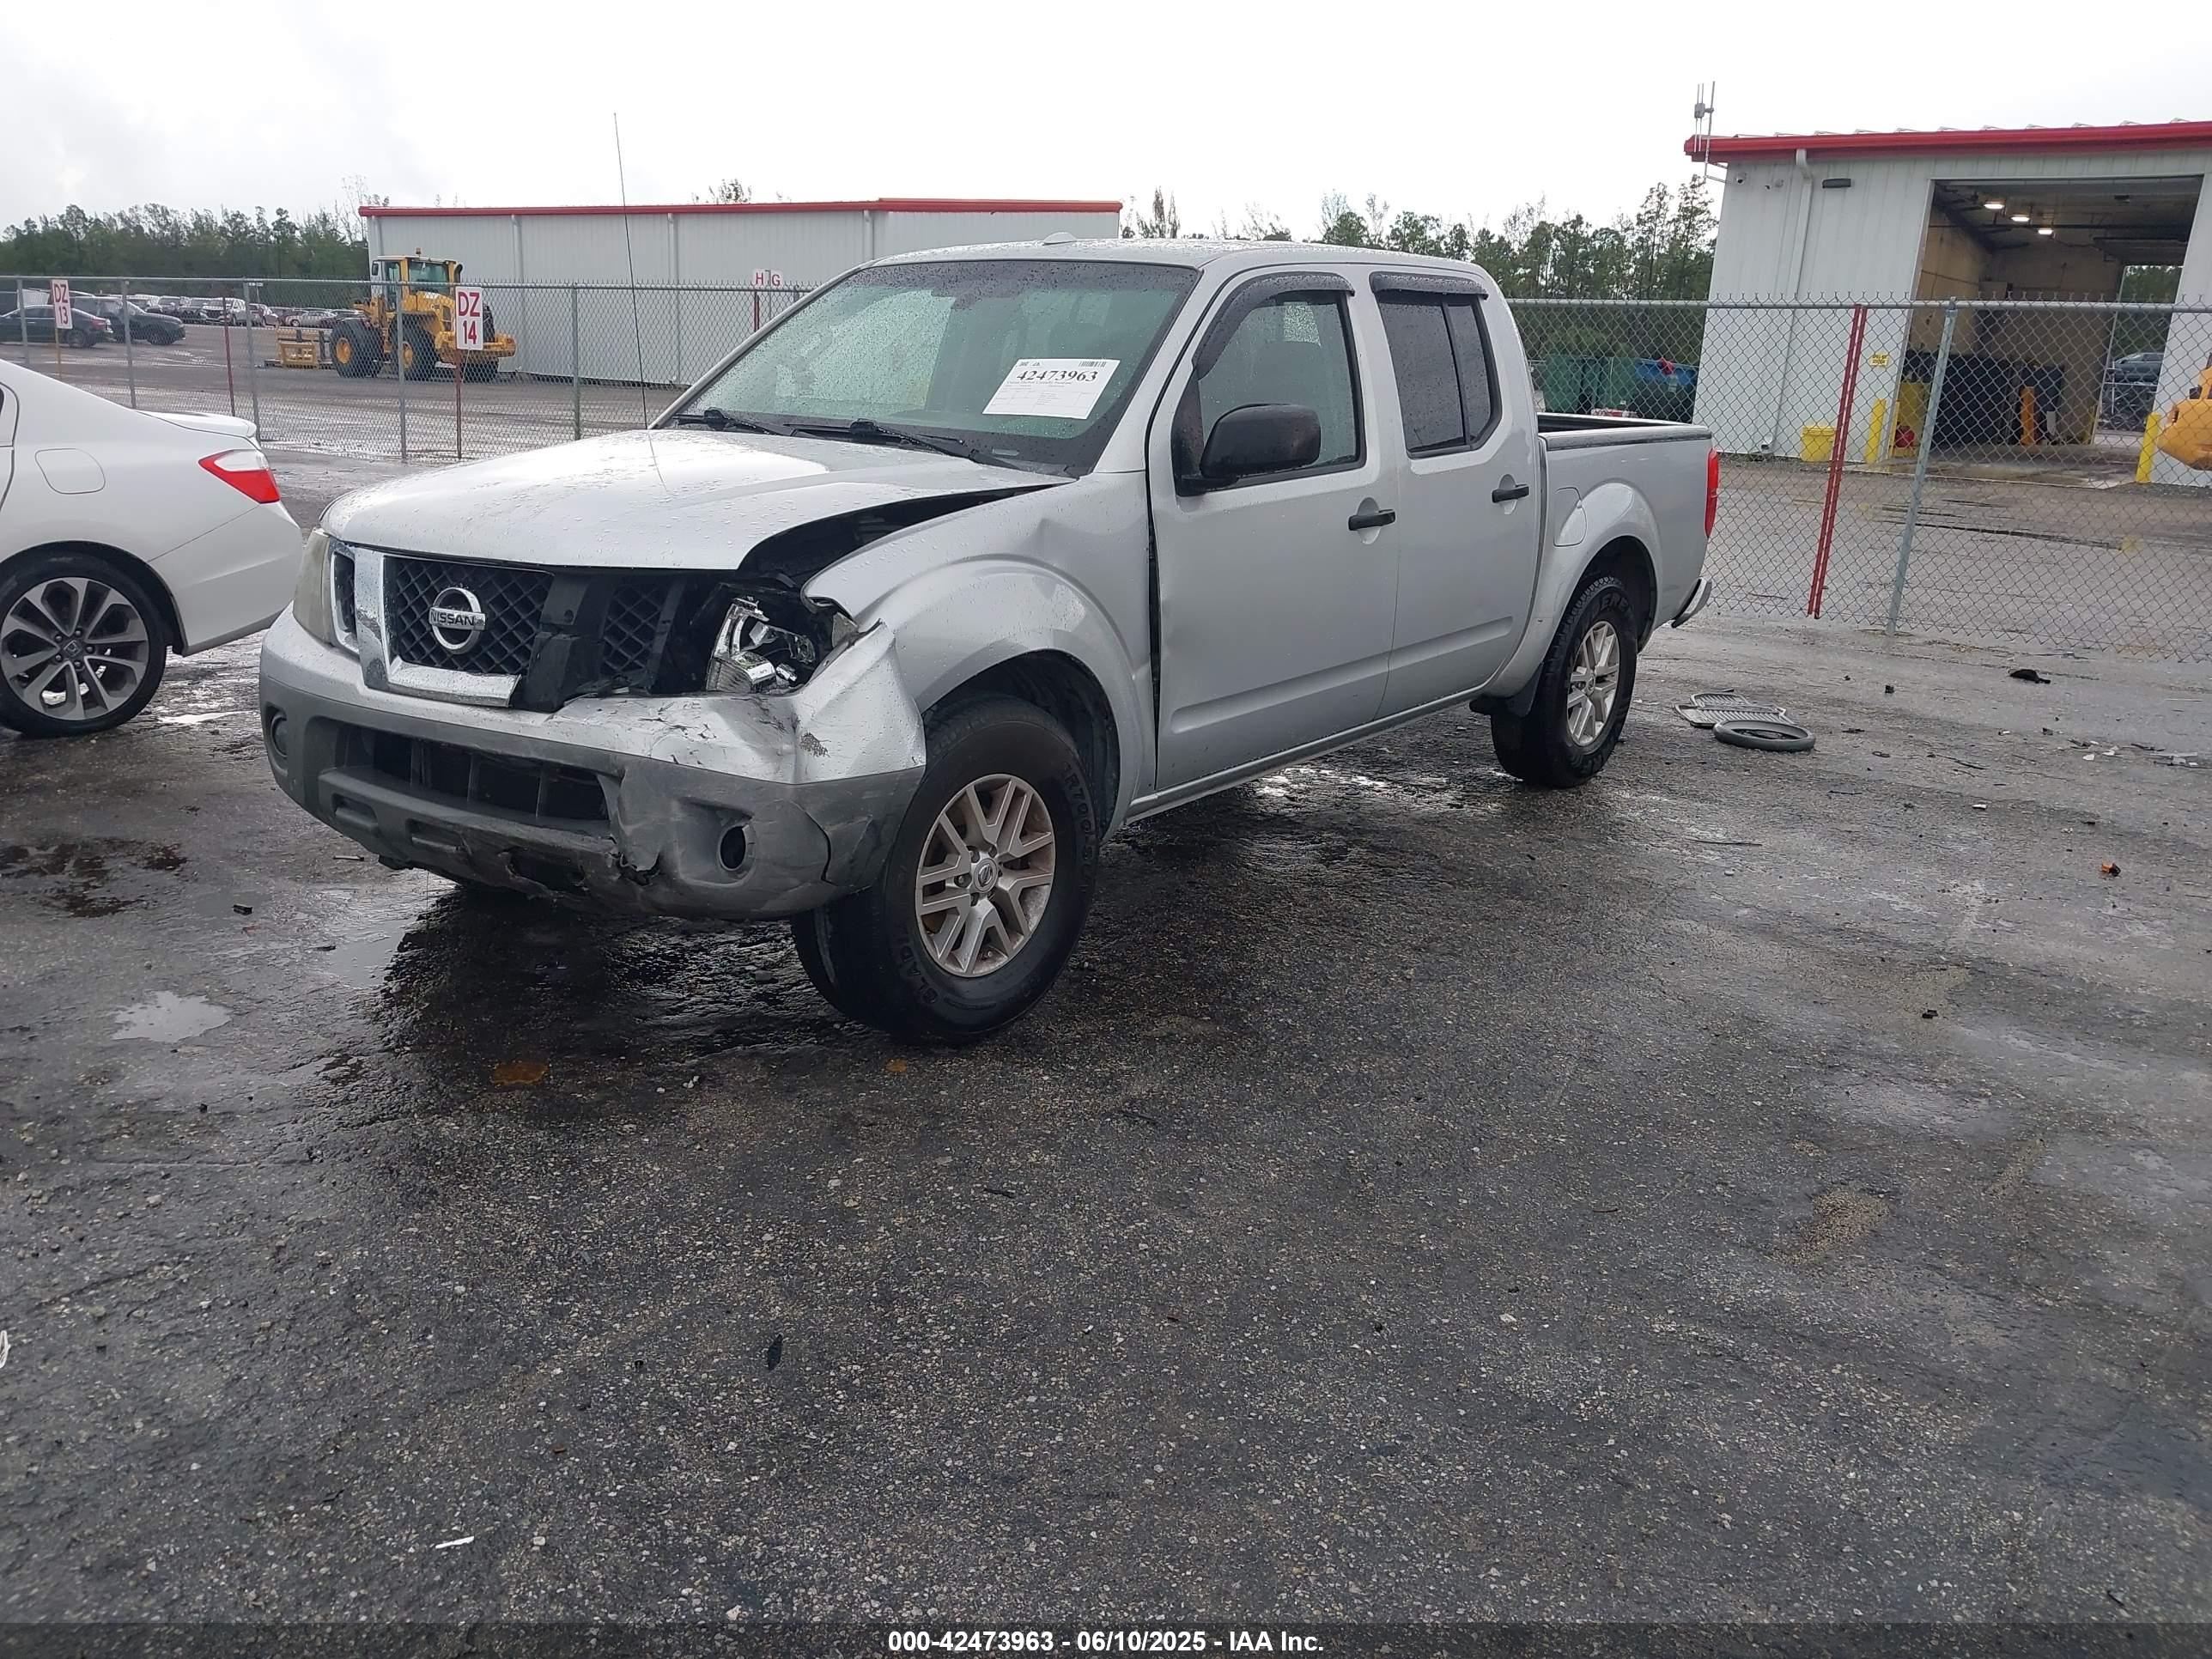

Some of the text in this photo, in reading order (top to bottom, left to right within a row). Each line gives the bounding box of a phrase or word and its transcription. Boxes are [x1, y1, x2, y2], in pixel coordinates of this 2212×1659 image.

[54, 284, 68, 302] DZ
[458, 292, 480, 317] DZ
[59, 306, 68, 325] 13
[463, 320, 477, 343] 14
[1017, 370, 1098, 382] 42473963
[431, 611, 475, 626] NISSAN
